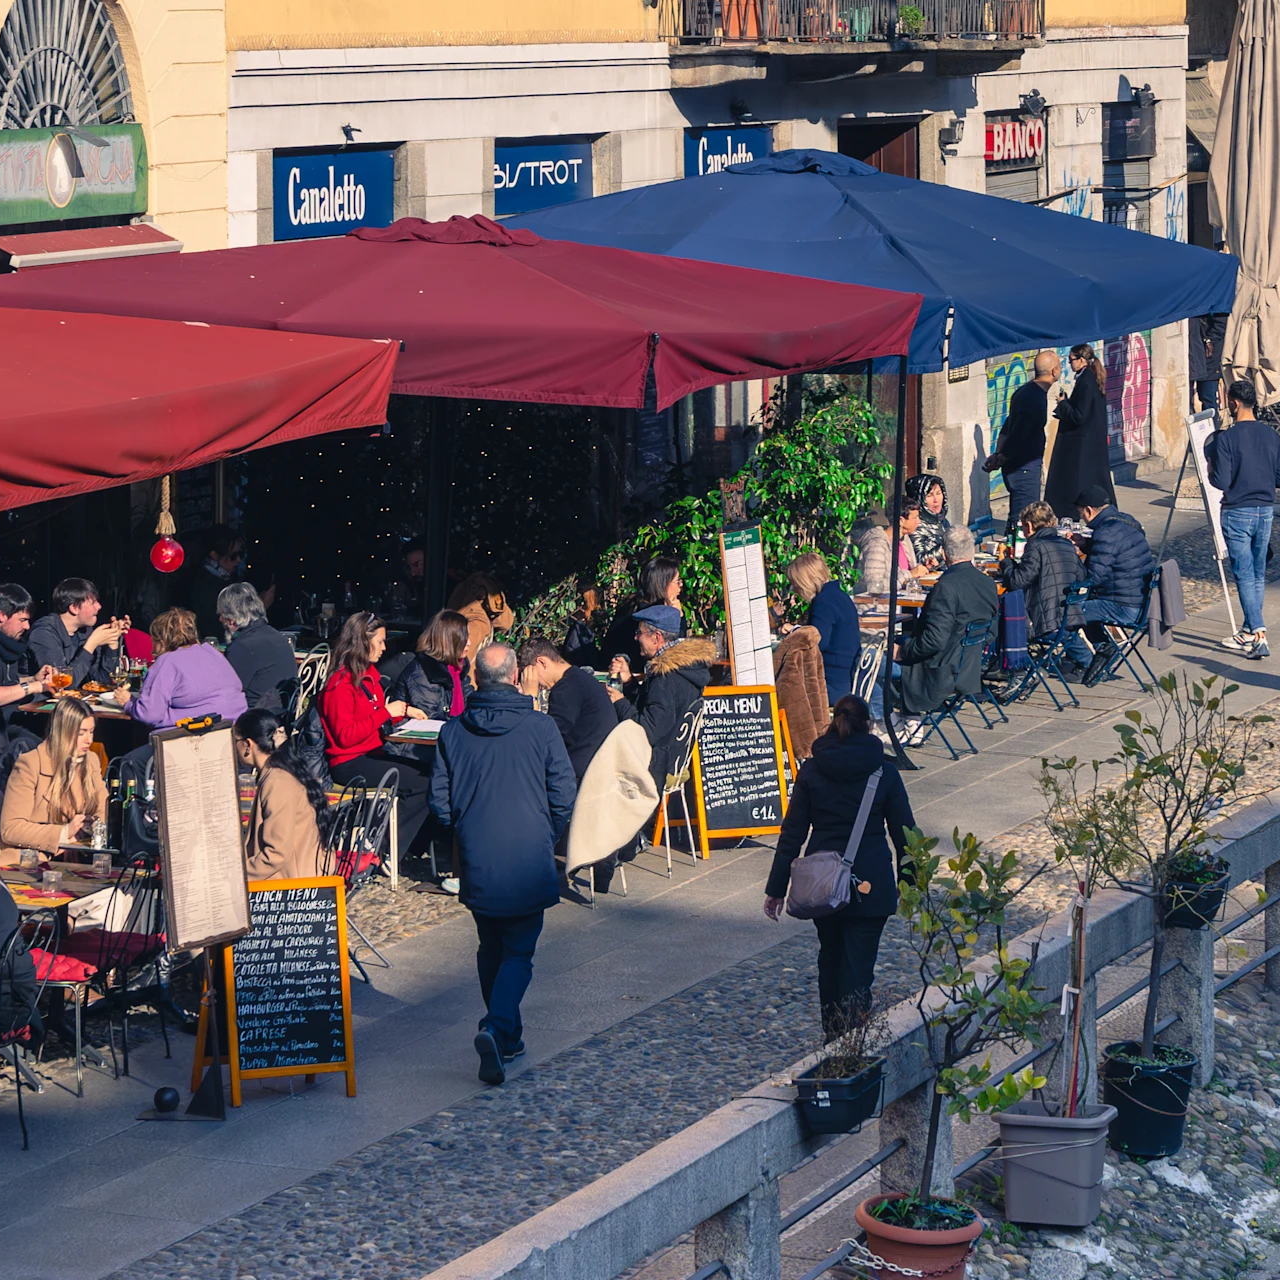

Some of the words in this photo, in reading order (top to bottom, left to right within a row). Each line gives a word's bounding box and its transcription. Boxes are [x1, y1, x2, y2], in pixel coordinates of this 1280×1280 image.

[994, 118, 1046, 161] BANCO
[288, 165, 366, 227] Canaletto
[704, 699, 733, 715] PECIAL
[752, 805, 777, 820] €14
[287, 887, 318, 901] MENU
[238, 1002, 285, 1016] HAMBURGER
[240, 1027, 287, 1043] CAPRESE
